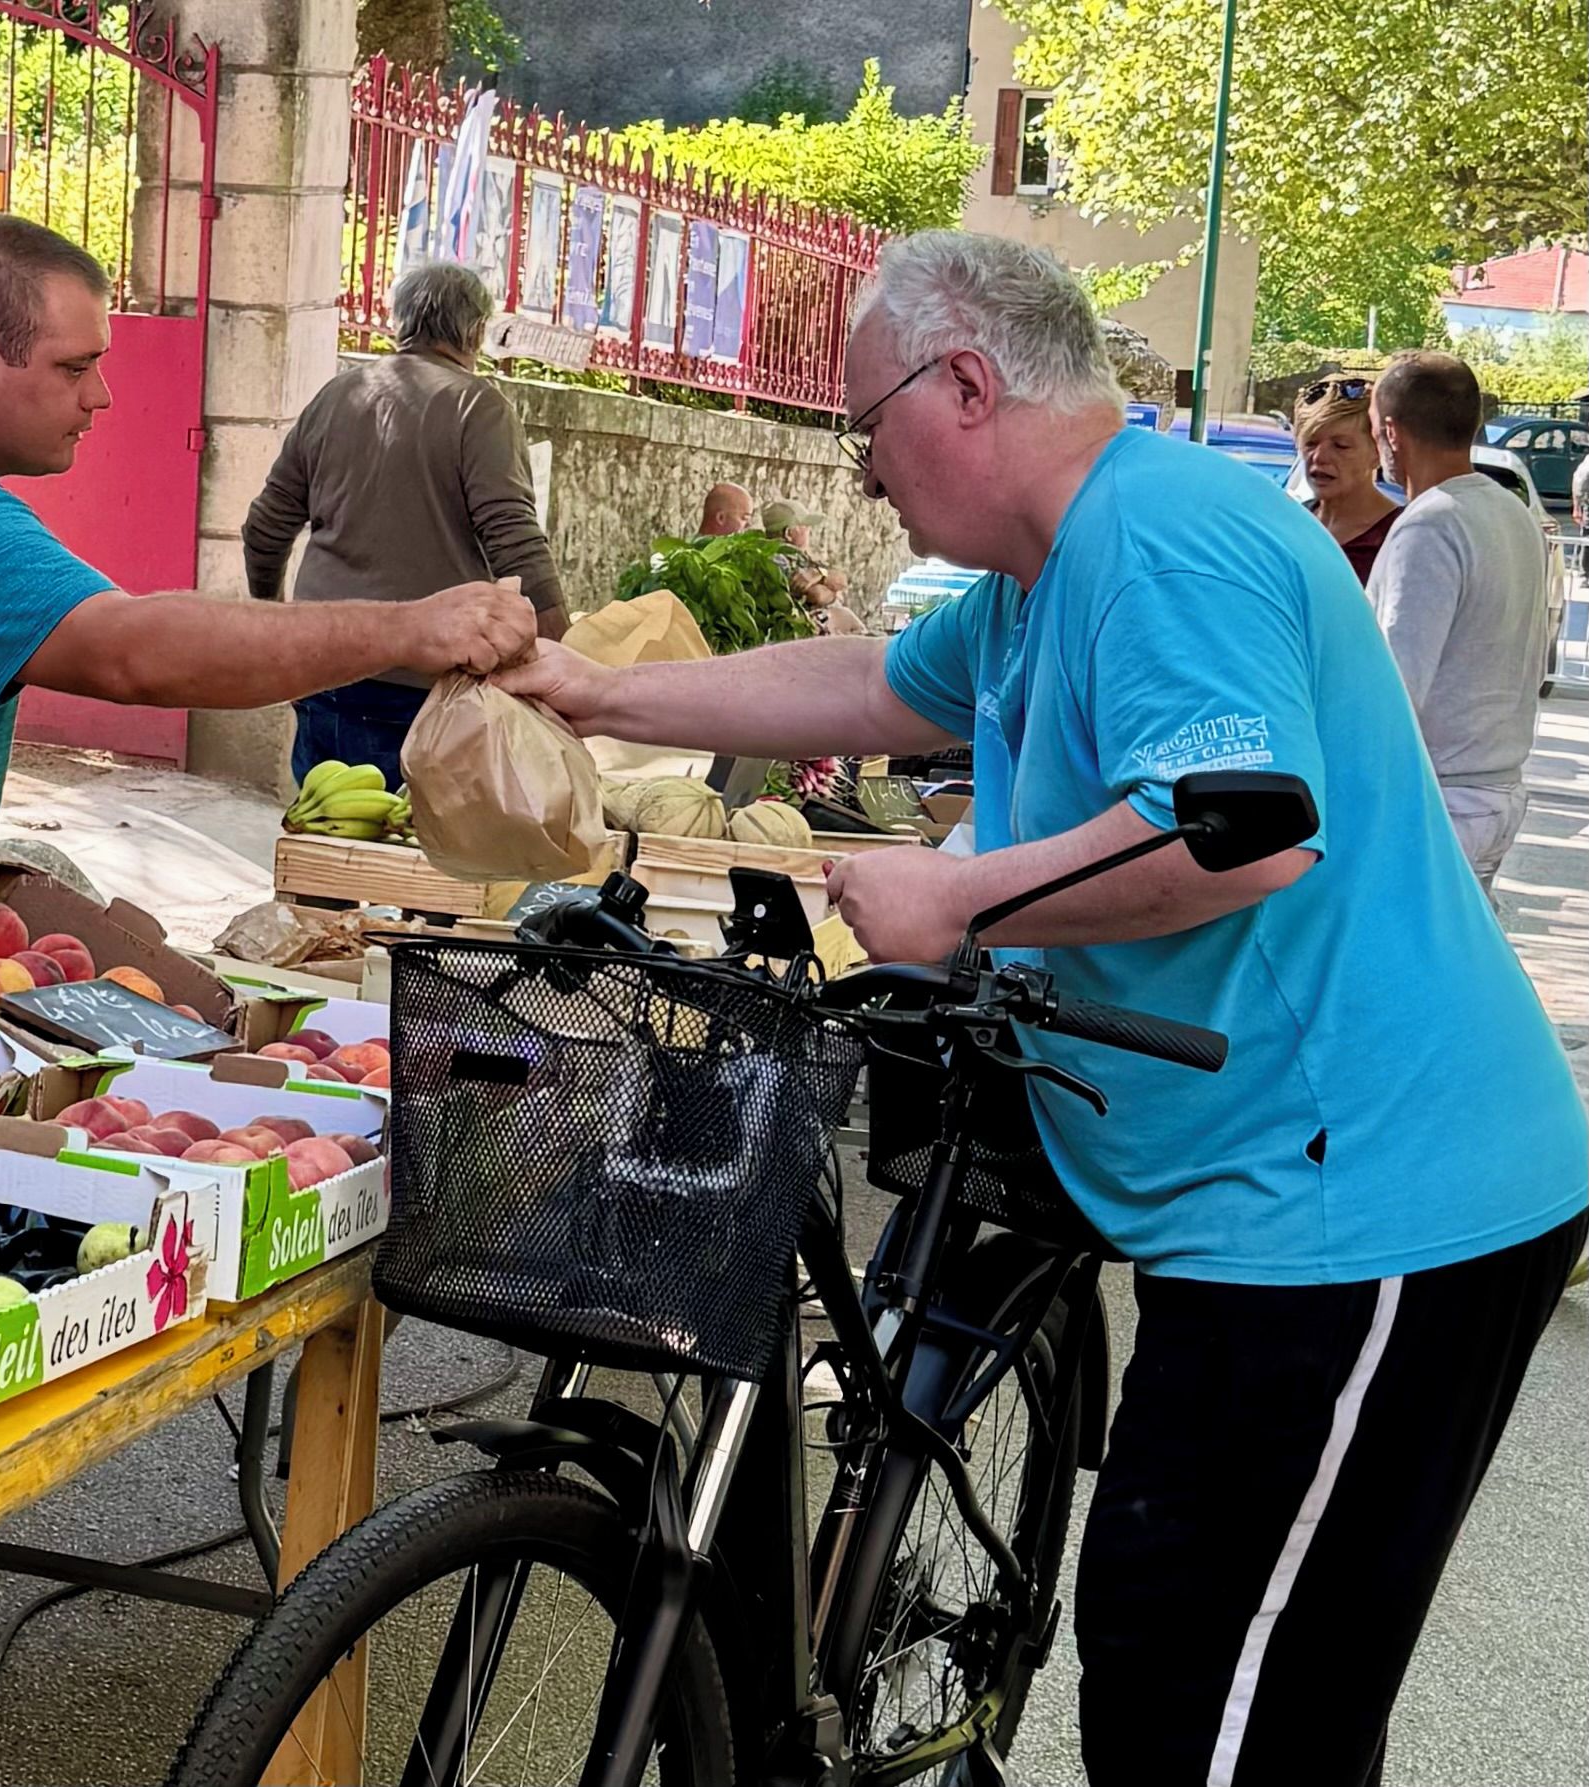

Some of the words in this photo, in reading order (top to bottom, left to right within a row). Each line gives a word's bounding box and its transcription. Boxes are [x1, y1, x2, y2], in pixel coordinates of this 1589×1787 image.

[269, 1201, 322, 1271] Soleil
[328, 1202, 351, 1245] des
[355, 1190, 378, 1232] îles
[50, 1315, 89, 1366] des
[98, 1295, 137, 1346] îles
